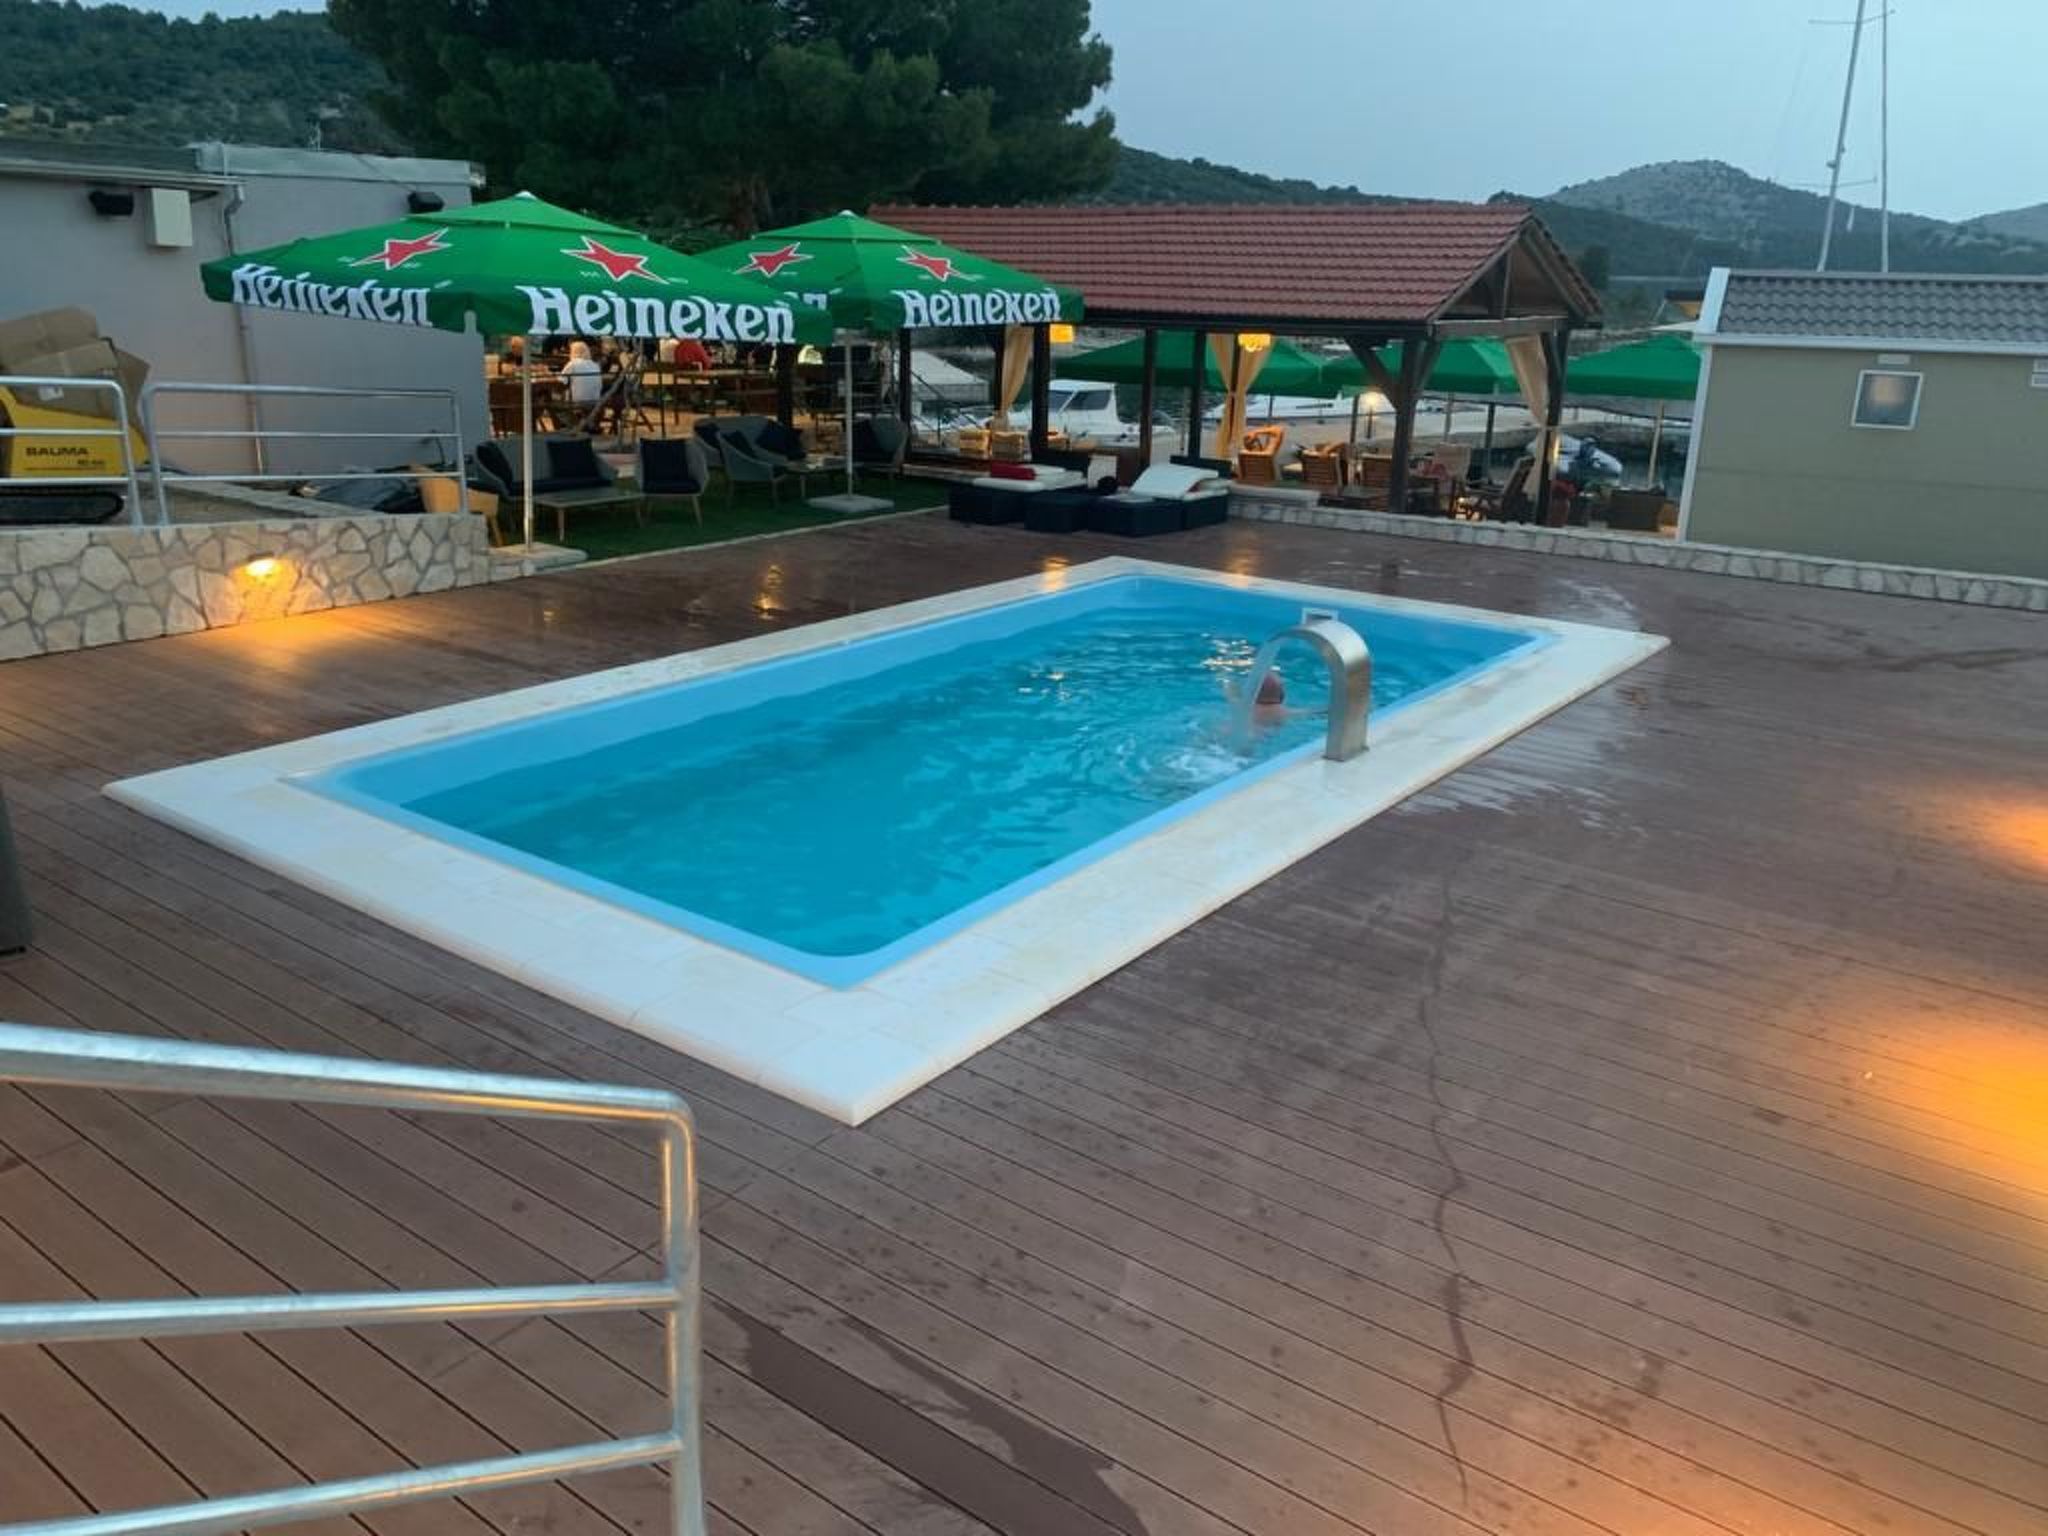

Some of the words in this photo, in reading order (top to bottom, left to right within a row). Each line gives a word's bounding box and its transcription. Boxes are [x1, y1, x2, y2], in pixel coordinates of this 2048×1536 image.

[231, 263, 433, 327] Heineken
[515, 285, 796, 343] Heineken
[890, 287, 1062, 328] Heineken
[26, 447, 88, 456] BAUMA
